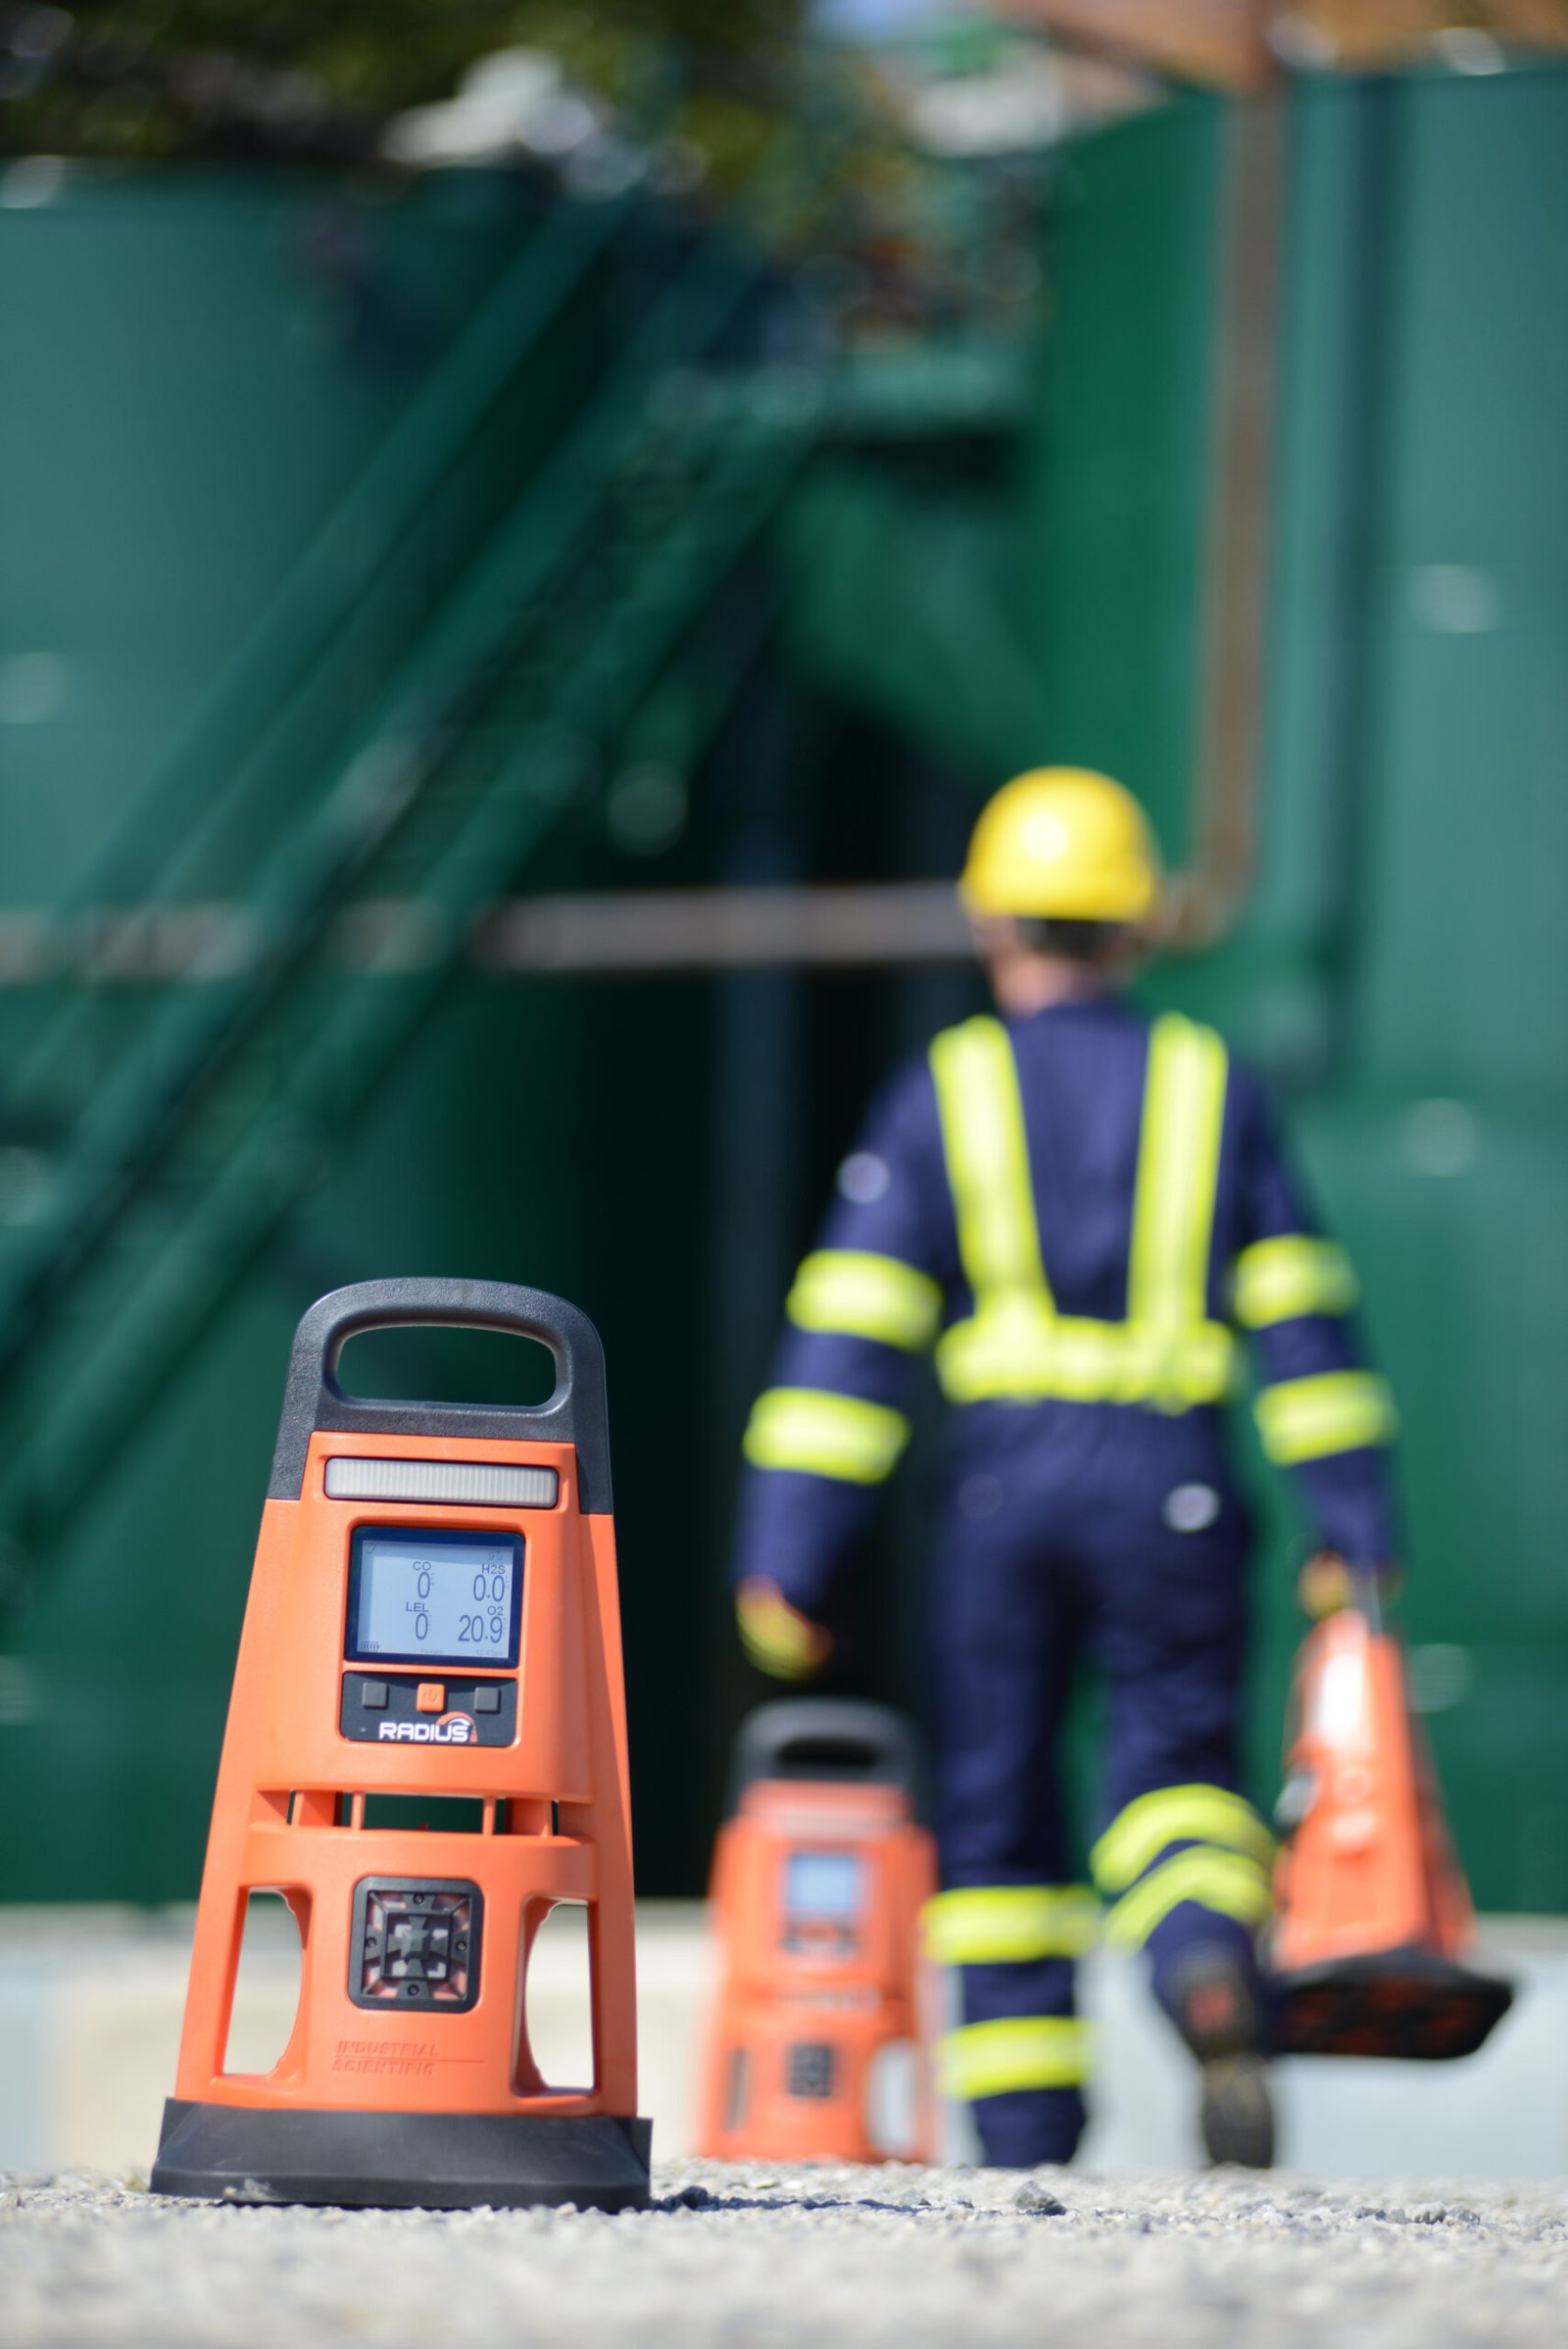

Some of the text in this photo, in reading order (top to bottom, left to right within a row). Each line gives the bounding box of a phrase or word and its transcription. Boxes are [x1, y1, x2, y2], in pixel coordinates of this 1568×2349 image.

[413, 1561, 431, 1571] CO
[481, 1563, 506, 1574] H2S
[417, 1572, 430, 1598] 0
[473, 1574, 505, 1601] 0.0
[406, 1601, 429, 1612] LEL
[487, 1605, 504, 1616] O2
[416, 1613, 428, 1639] 0
[458, 1615, 503, 1643] 20.9
[378, 1722, 468, 1742] RADIUS
[337, 2040, 439, 2056] INDUSTRIAL
[331, 2060, 435, 2076] SCIENTIFIC
